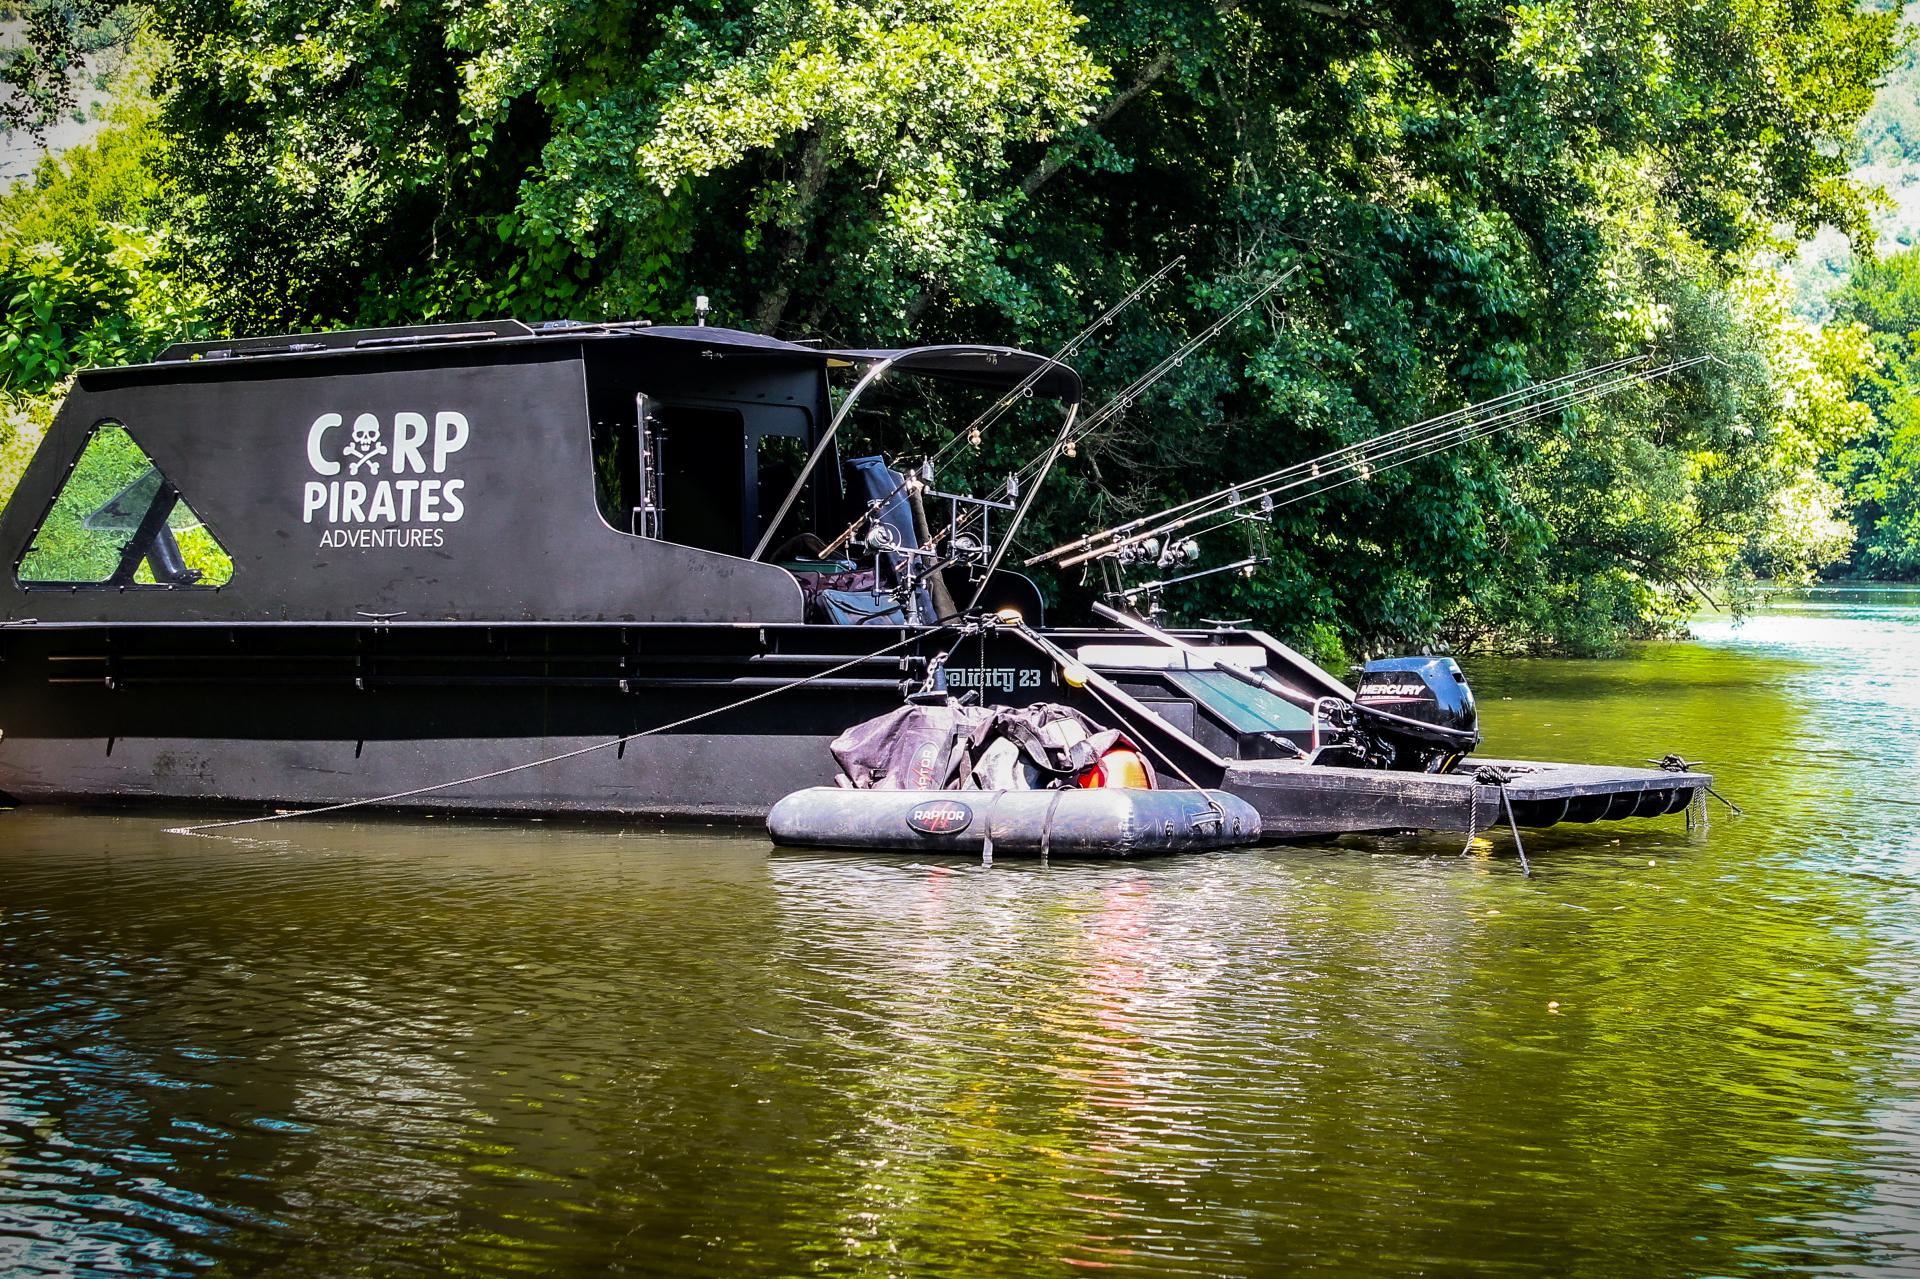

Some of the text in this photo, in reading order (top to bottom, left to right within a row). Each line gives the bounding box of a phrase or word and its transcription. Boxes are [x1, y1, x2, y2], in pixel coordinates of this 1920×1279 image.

[307, 411, 470, 476] CRP
[303, 479, 465, 523] PIRATES
[319, 528, 444, 548] ADVENTURES
[1019, 669, 1041, 687] 23
[1360, 684, 1426, 696] MERCURY
[918, 750, 932, 791] APTOR
[913, 810, 965, 821] RAPTOR
